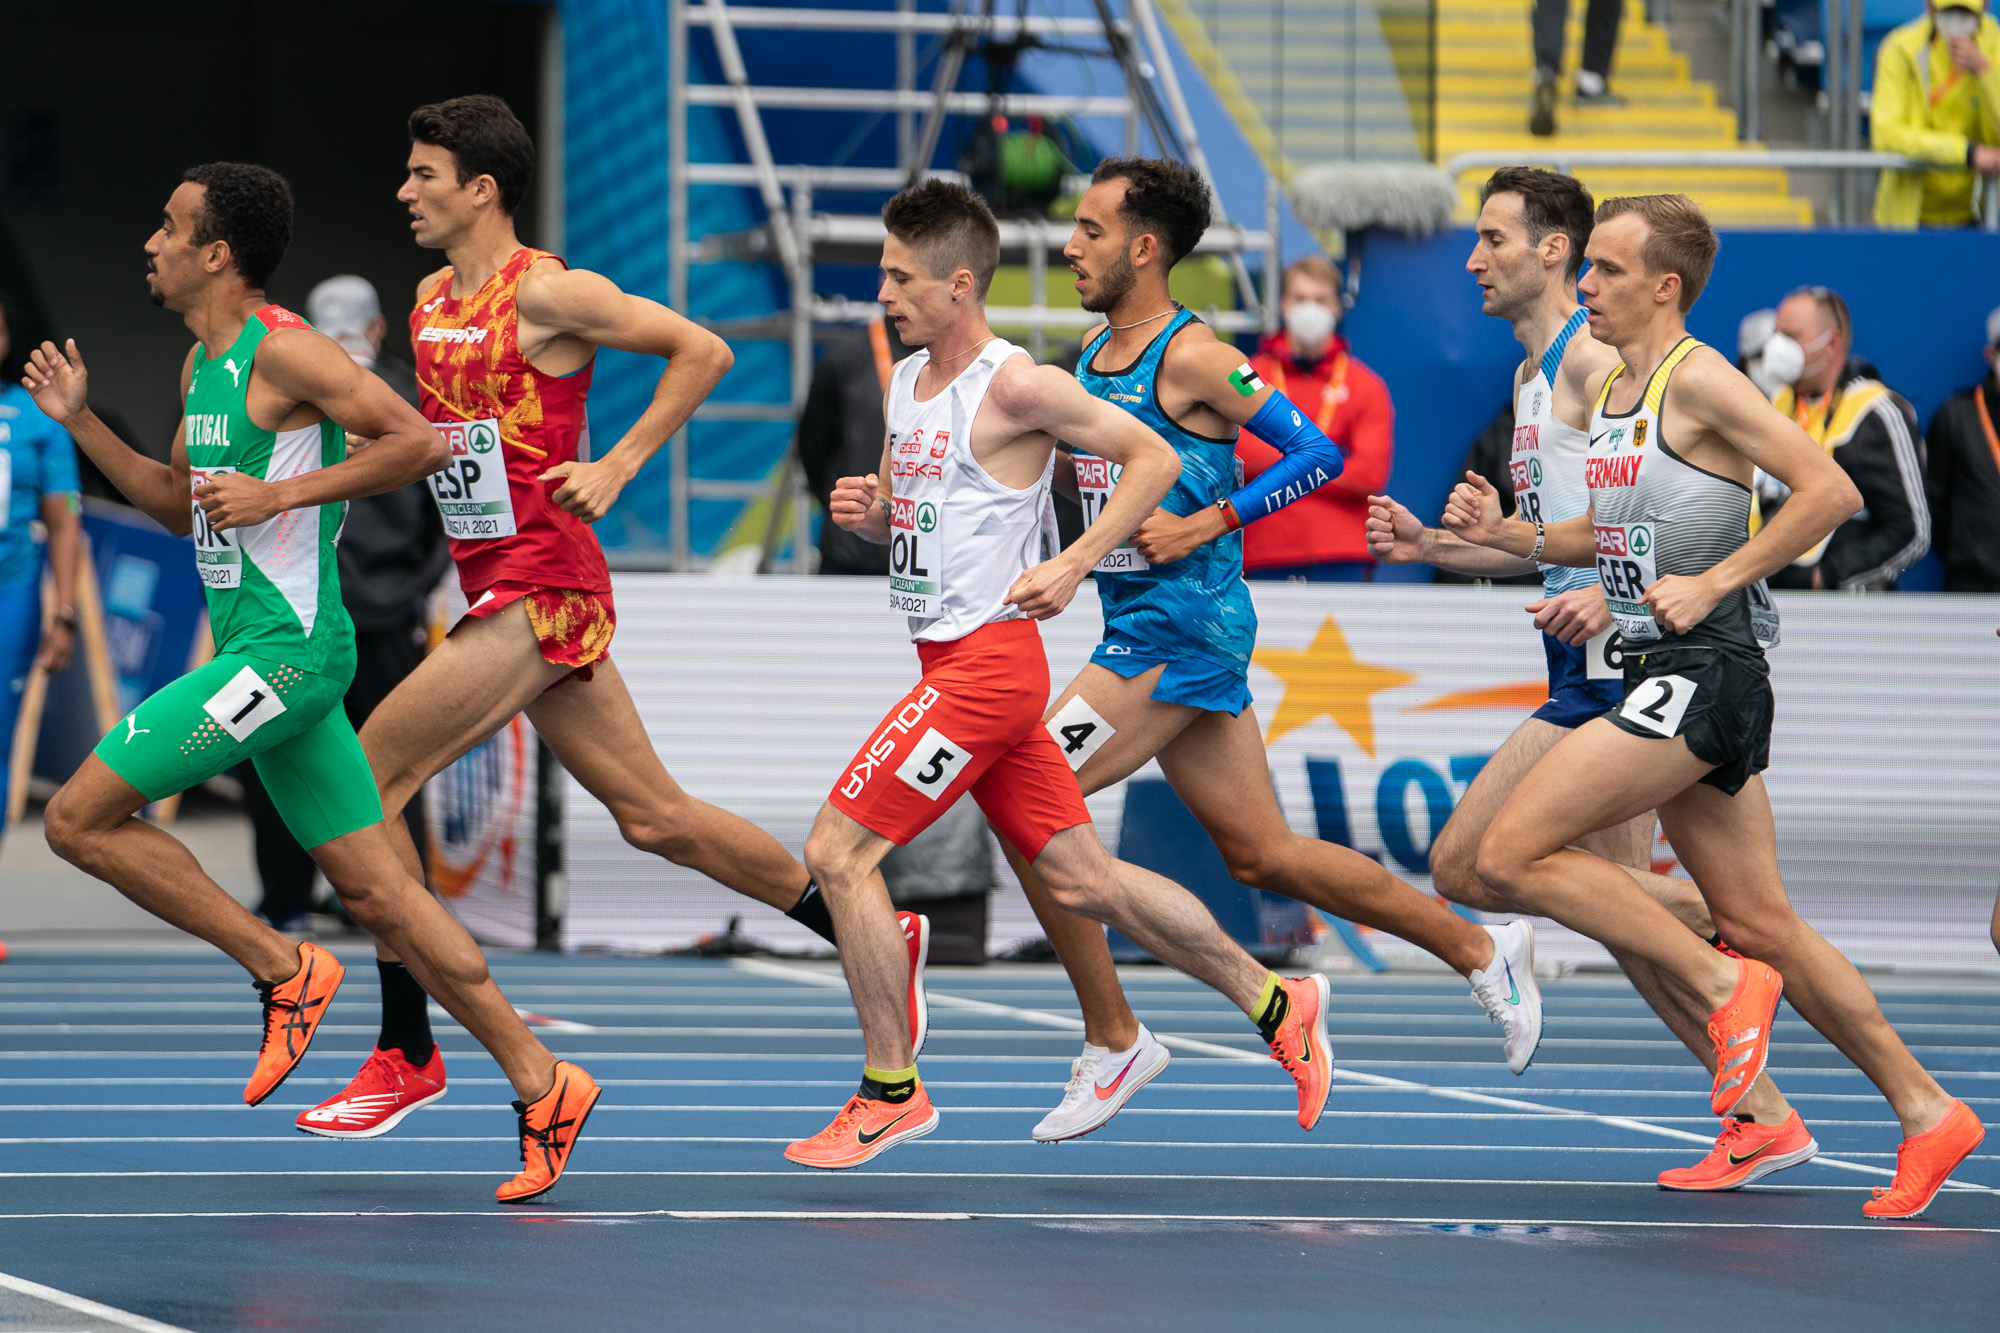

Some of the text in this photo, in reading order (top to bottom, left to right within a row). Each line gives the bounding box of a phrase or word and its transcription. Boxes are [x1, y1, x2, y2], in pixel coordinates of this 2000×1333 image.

[418, 326, 488, 343] ESPAÑA
[185, 414, 231, 446] ORTUGAL
[434, 459, 481, 499] ESP
[890, 461, 942, 481] OLSKA
[1076, 462, 1106, 484] PAR
[1511, 464, 1529, 487] PAR
[1585, 455, 1644, 488] GERMANY
[1265, 467, 1328, 513] ITALIA
[472, 519, 499, 534] 2021
[891, 500, 914, 526] PAR
[892, 532, 928, 577] OL
[1594, 530, 1626, 553] PAR
[1598, 557, 1645, 599] GER
[890, 594, 926, 613] SIA 2021
[1603, 629, 1625, 670] 6
[231, 690, 266, 725] 1
[1639, 680, 1673, 723] 2
[840, 685, 941, 799] POLSKA
[1059, 722, 1097, 755] 4
[916, 746, 955, 784] 5
